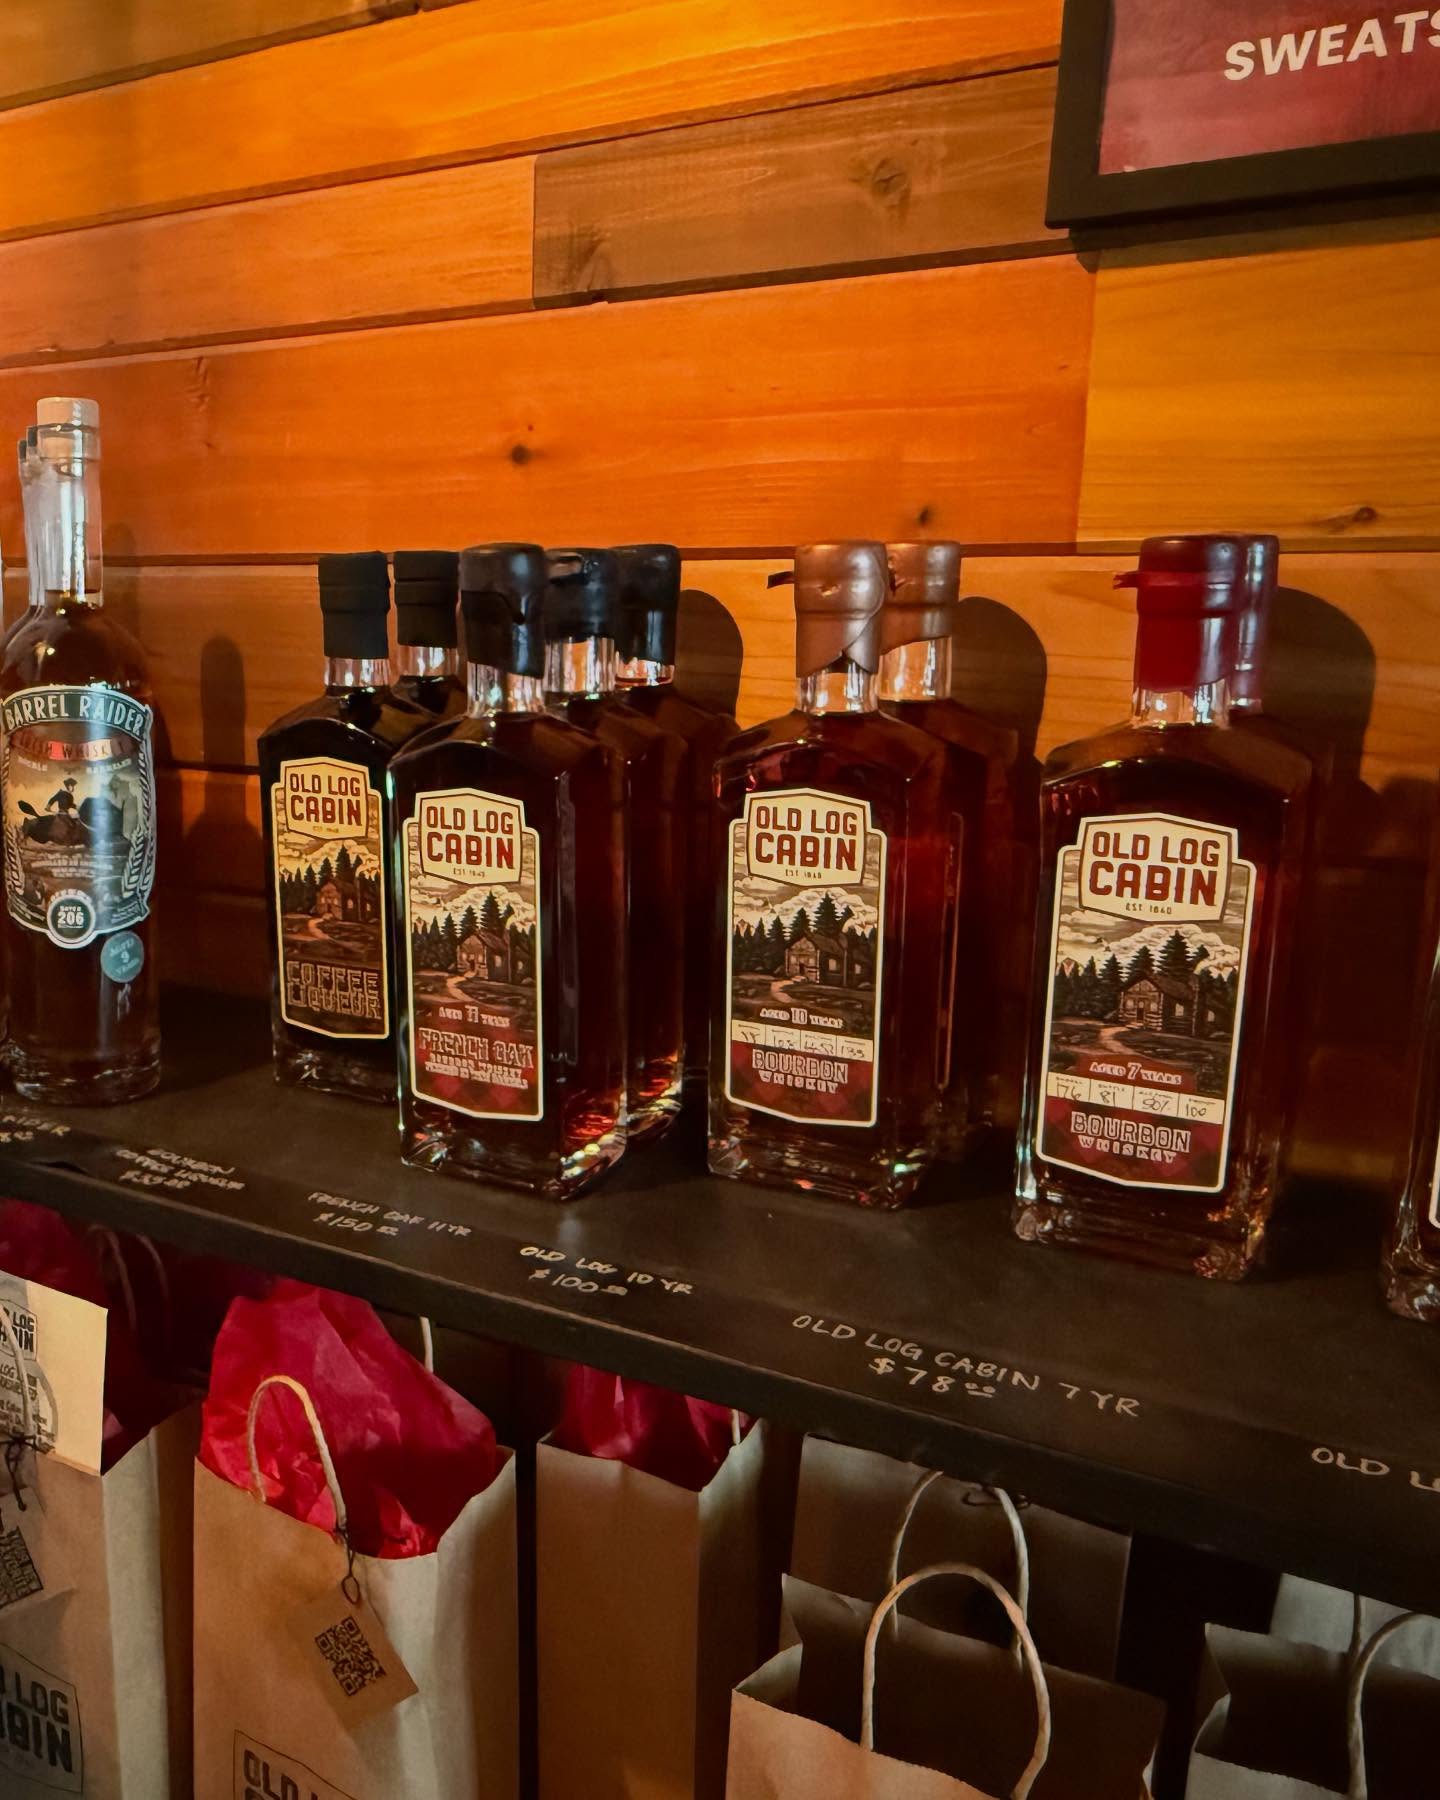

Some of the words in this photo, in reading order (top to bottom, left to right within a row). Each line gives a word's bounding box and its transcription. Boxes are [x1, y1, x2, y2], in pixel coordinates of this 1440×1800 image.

[5, 694, 69, 730] BARREL
[79, 695, 145, 736] RAIDER
[290, 773, 321, 793] OLD
[328, 775, 361, 796] LOG
[290, 795, 362, 826] CABIN
[426, 806, 466, 830] OLD
[473, 809, 514, 835] LOG
[756, 806, 802, 831] OLD
[811, 809, 858, 836] LOG
[426, 831, 515, 870] CABIN
[755, 832, 857, 871] CABIN
[1092, 831, 1150, 861] OLD
[1160, 836, 1220, 867] LOG
[1089, 860, 1217, 906] CABIN
[57, 911, 85, 926] 206
[286, 960, 379, 992] COFFEE
[791, 1007, 808, 1025] 10
[418, 1027, 490, 1062] FRENCH
[492, 1040, 535, 1069] OAK
[752, 1048, 849, 1085] BOURBON
[758, 1069, 839, 1094] WHISKEY
[1089, 1061, 1127, 1077] AGED
[1127, 1062, 1143, 1080] 7
[1141, 1068, 1182, 1085] YEARS
[1070, 1111, 1192, 1153] BOURBON
[1077, 1134, 1178, 1164] WHISKEY
[307, 1192, 380, 1214] FRENCH
[426, 1221, 447, 1233] 11
[519, 1246, 567, 1262] OLD
[575, 1258, 619, 1275] LOG
[627, 1271, 654, 1285] 10
[660, 1278, 694, 1295] YR
[791, 1315, 857, 1340] OLD
[865, 1333, 923, 1361] LOG
[934, 1352, 1041, 1391] CABIN
[1058, 1381, 1081, 1400] 7
[1090, 1390, 1141, 1418] YR
[1311, 1447, 1391, 1476] OLD
[15, 1671, 70, 1725] LOG
[0, 1702, 73, 1773] BIN
[243, 1749, 300, 1800] OLD
